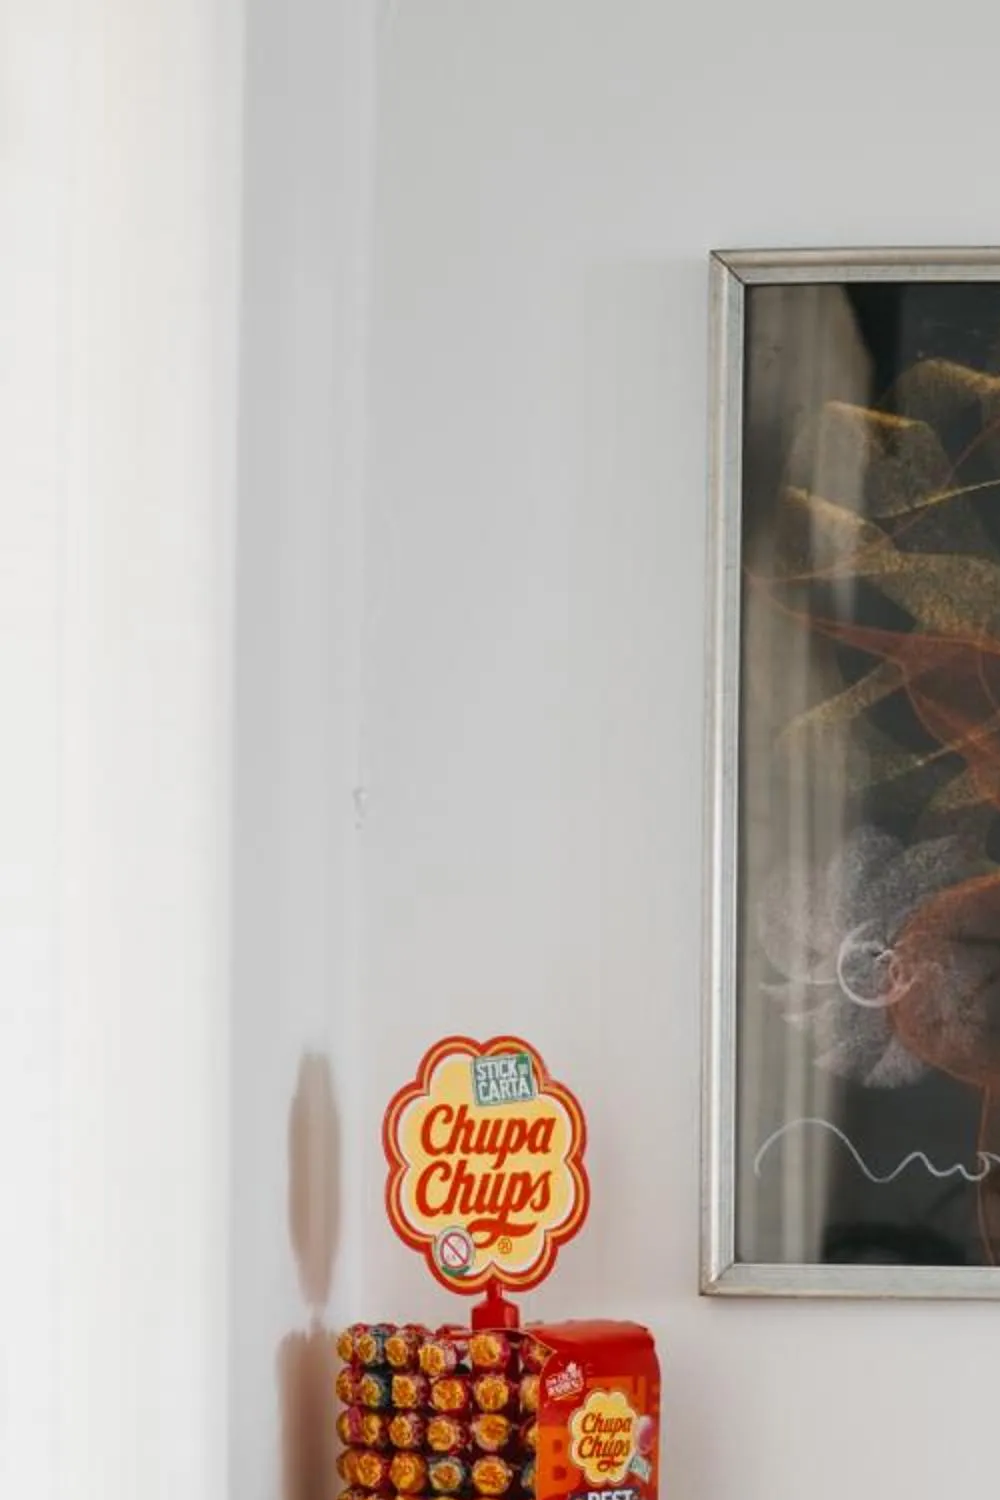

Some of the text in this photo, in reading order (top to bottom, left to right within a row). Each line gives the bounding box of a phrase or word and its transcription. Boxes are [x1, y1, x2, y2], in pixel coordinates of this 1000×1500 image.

[476, 1060, 517, 1081] STICK
[478, 1077, 531, 1101] CARTA
[421, 1104, 556, 1170] Chupa
[415, 1160, 552, 1248] Chups
[581, 1412, 633, 1438] Chupa
[577, 1435, 631, 1473] Chups
